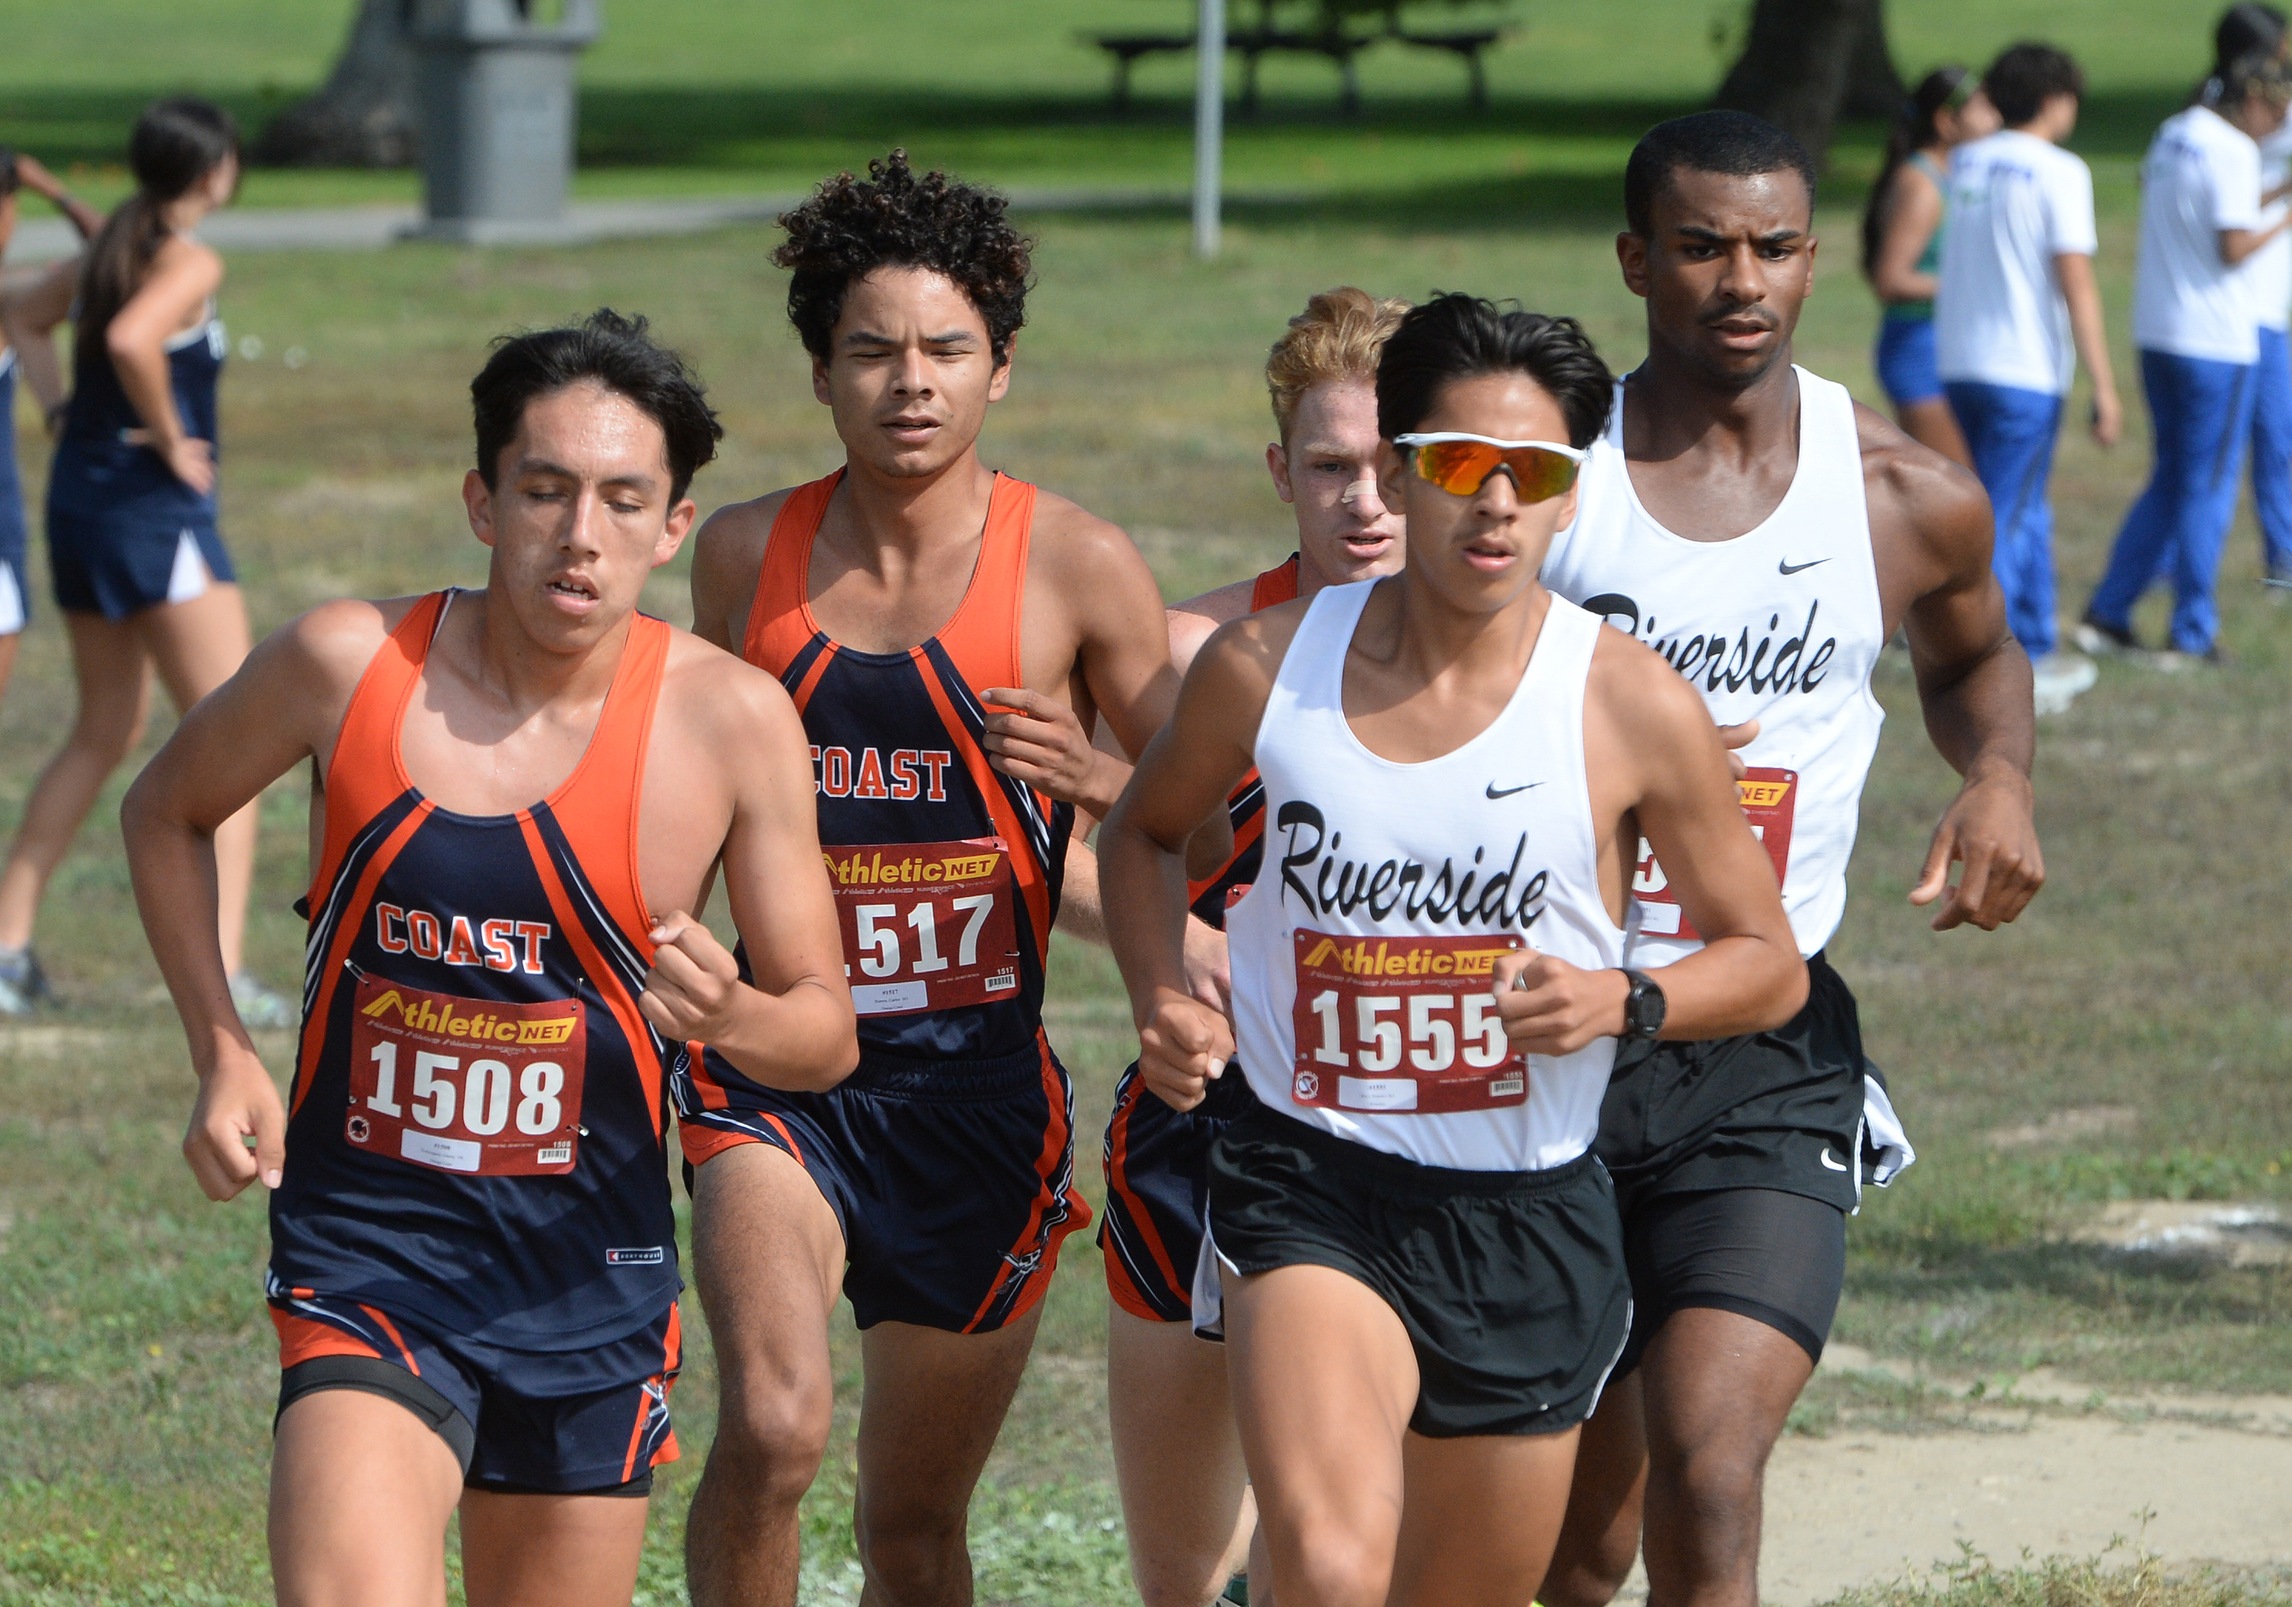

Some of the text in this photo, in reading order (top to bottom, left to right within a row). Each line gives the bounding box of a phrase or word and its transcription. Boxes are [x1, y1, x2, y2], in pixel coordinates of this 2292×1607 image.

[1581, 593, 1835, 694] erside
[950, 860, 991, 876] NET
[1278, 800, 1550, 929] Riverside
[376, 902, 550, 974] COAST
[844, 893, 994, 978] 517
[997, 966, 1014, 975] 1517
[1303, 938, 1455, 975] Athletic
[361, 990, 519, 1041] Athletic
[524, 1025, 565, 1040] NET
[1311, 990, 1508, 1072] 1555
[366, 1041, 564, 1136] 1508
[553, 1141, 571, 1149] 1508
